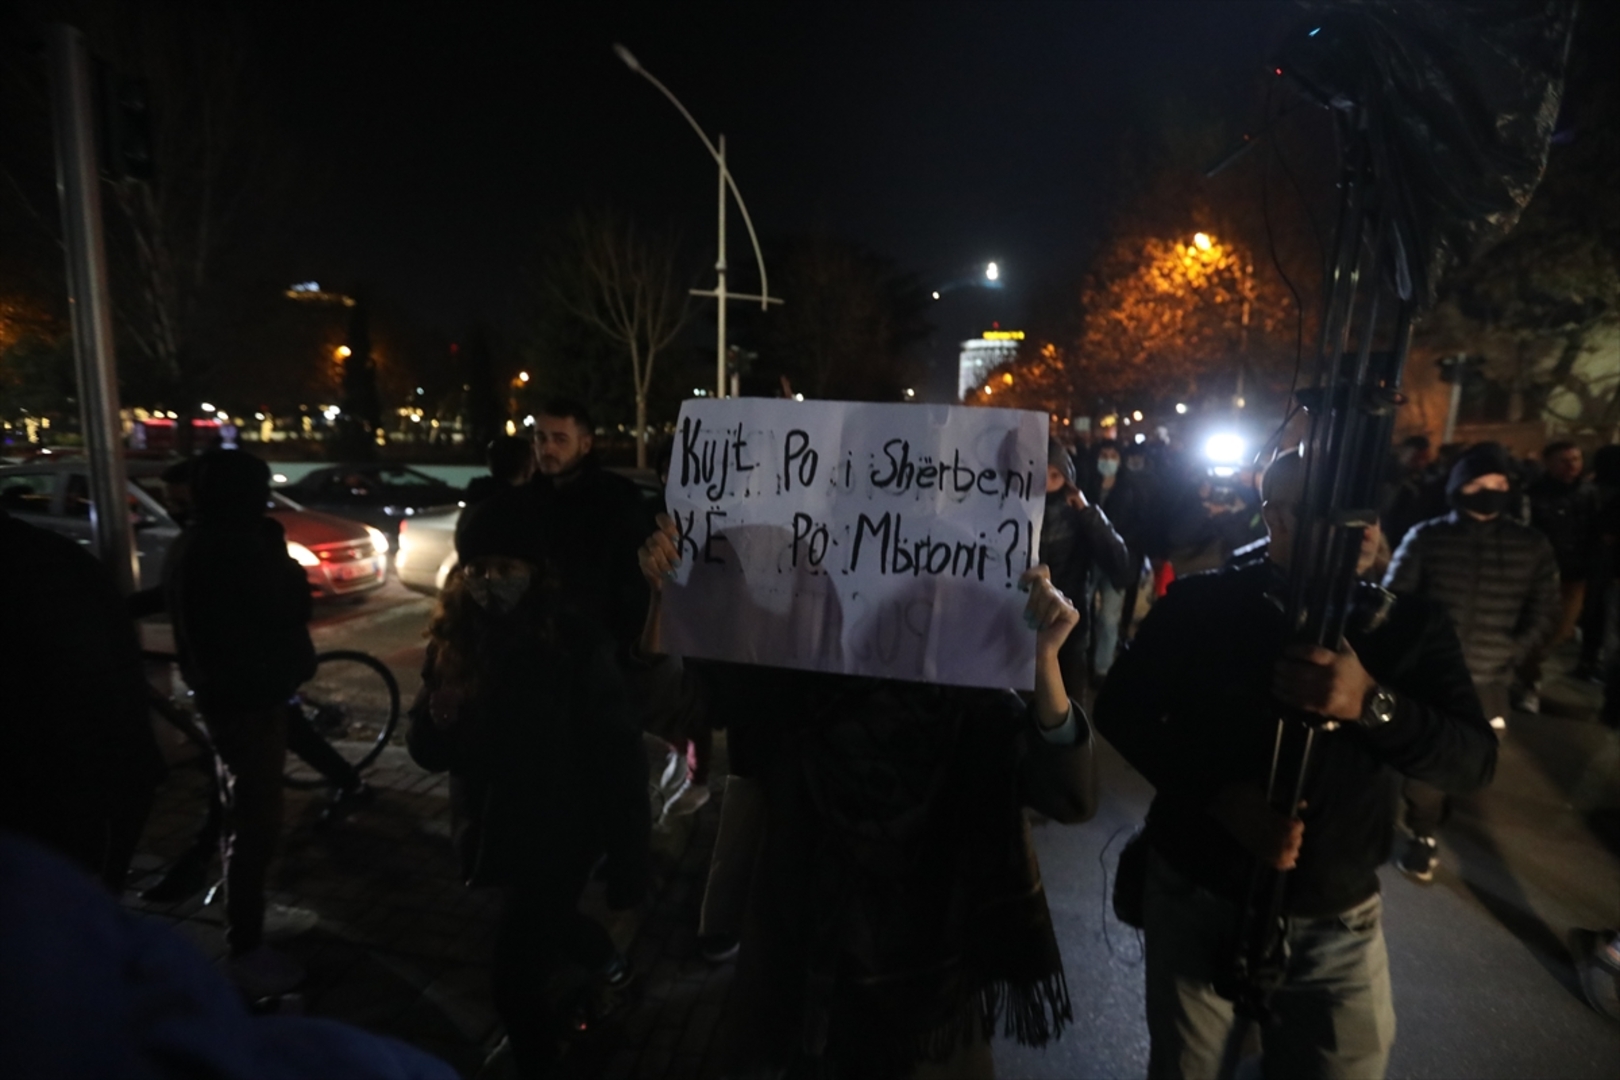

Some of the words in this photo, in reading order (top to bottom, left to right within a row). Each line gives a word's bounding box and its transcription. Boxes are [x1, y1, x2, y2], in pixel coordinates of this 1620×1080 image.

[680, 416, 754, 501] Kujt
[844, 450, 852, 488] i
[871, 439, 1033, 501] Shërbeni
[674, 505, 728, 564] KË
